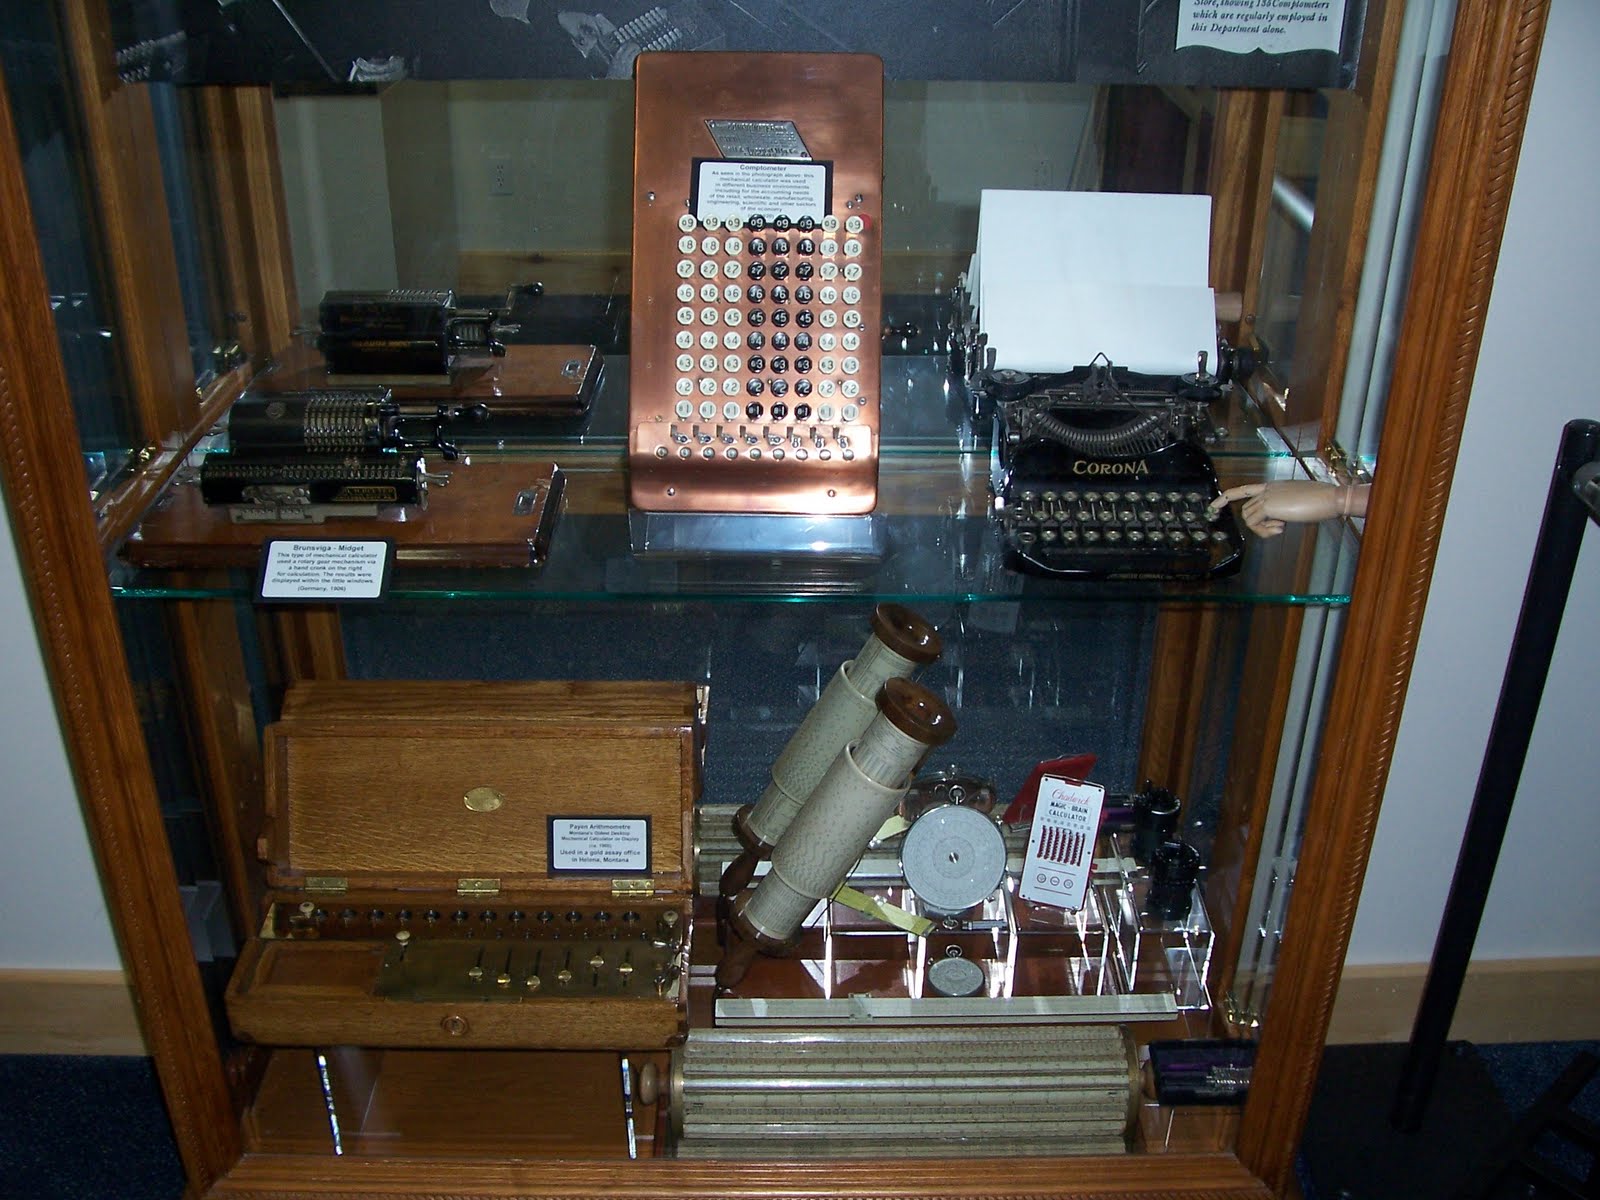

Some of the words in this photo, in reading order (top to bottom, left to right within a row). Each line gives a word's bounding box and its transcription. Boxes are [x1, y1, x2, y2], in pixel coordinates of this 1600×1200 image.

[1237, 12, 1274, 21] regularly
[1276, 14, 1315, 22] employed
[1210, 25, 1260, 34] Department
[1073, 459, 1148, 474] CORONA
[1049, 810, 1087, 822] CALCULATOR
